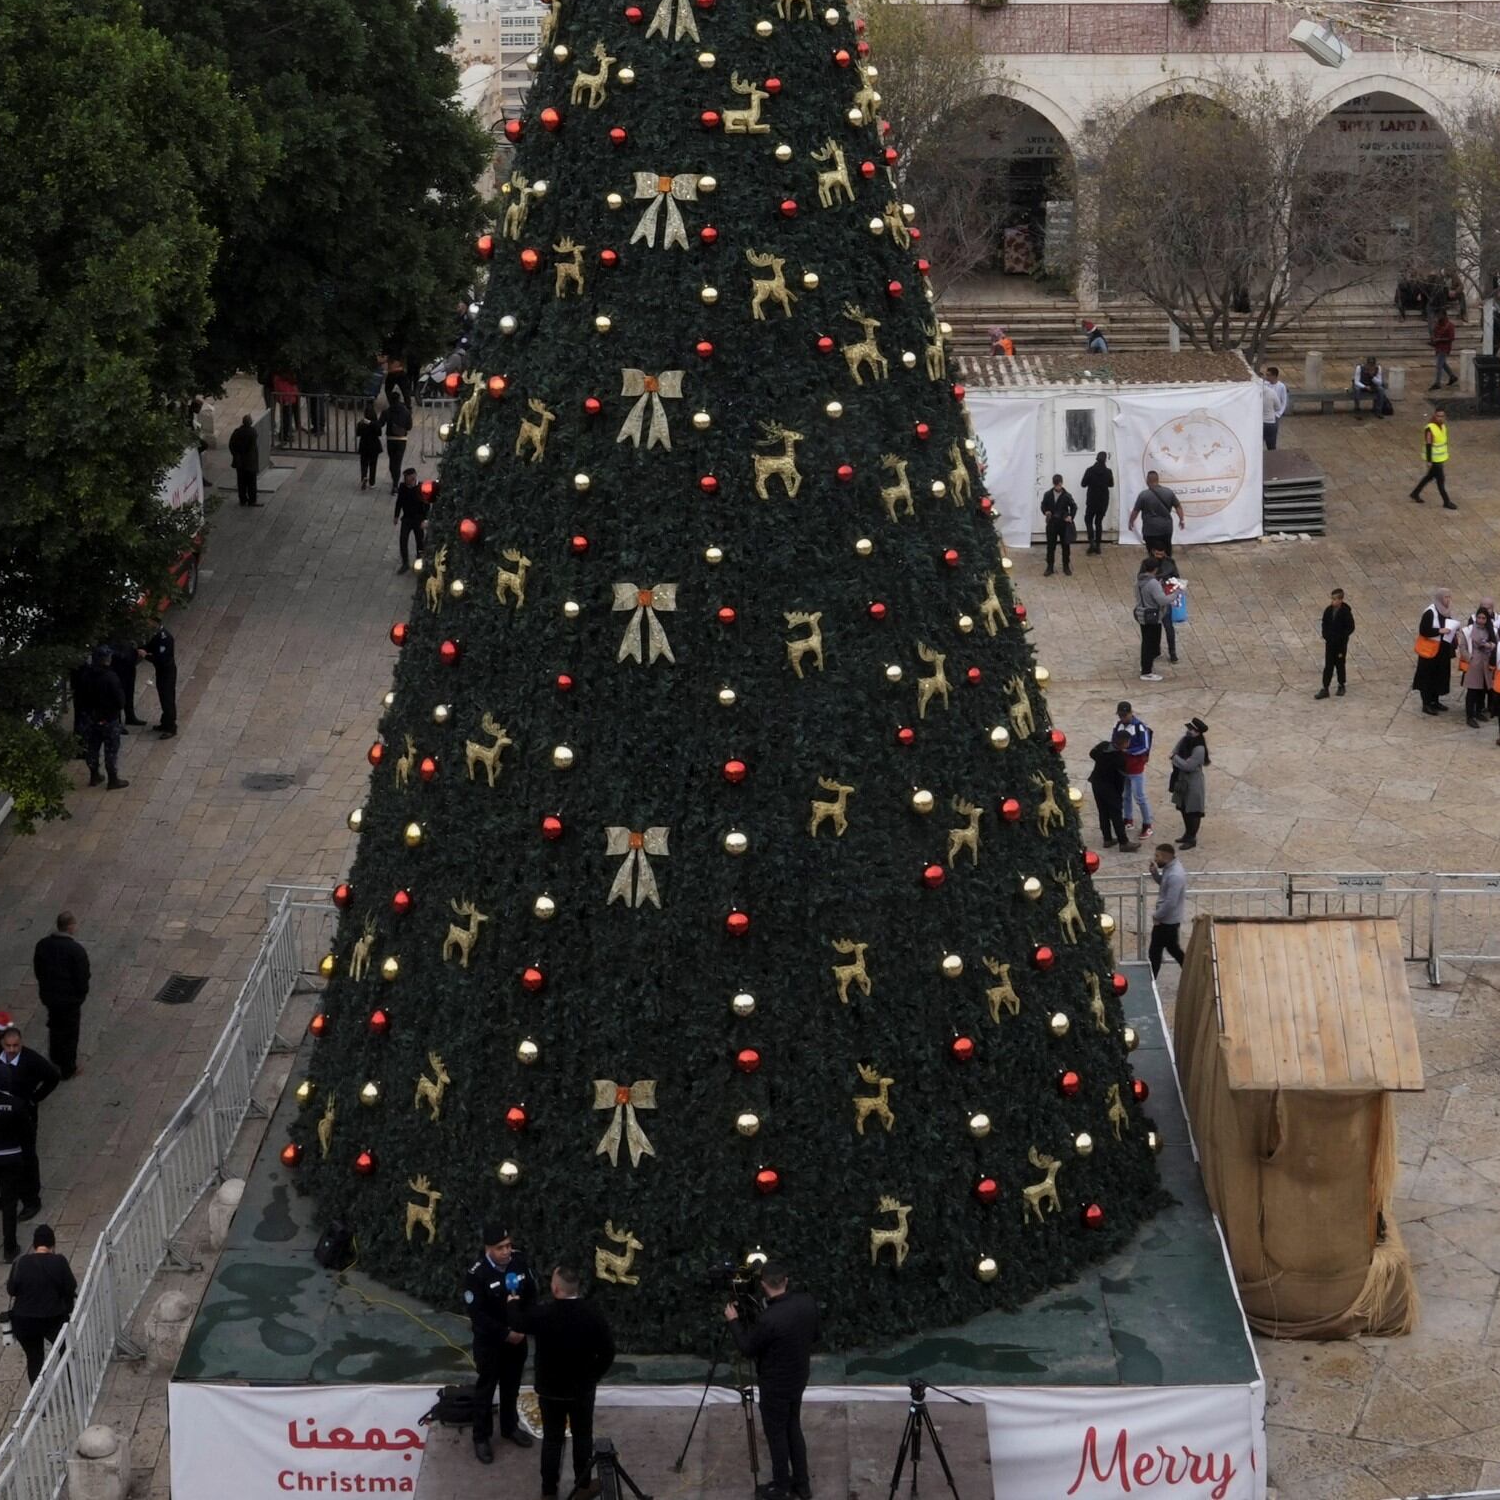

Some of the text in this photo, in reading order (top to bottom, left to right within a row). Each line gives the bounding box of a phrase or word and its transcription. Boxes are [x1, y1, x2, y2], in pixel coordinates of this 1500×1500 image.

[1379, 119, 1416, 132] LAND
[1067, 1426, 1236, 1499] Merry
[277, 1469, 417, 1493] Christma
